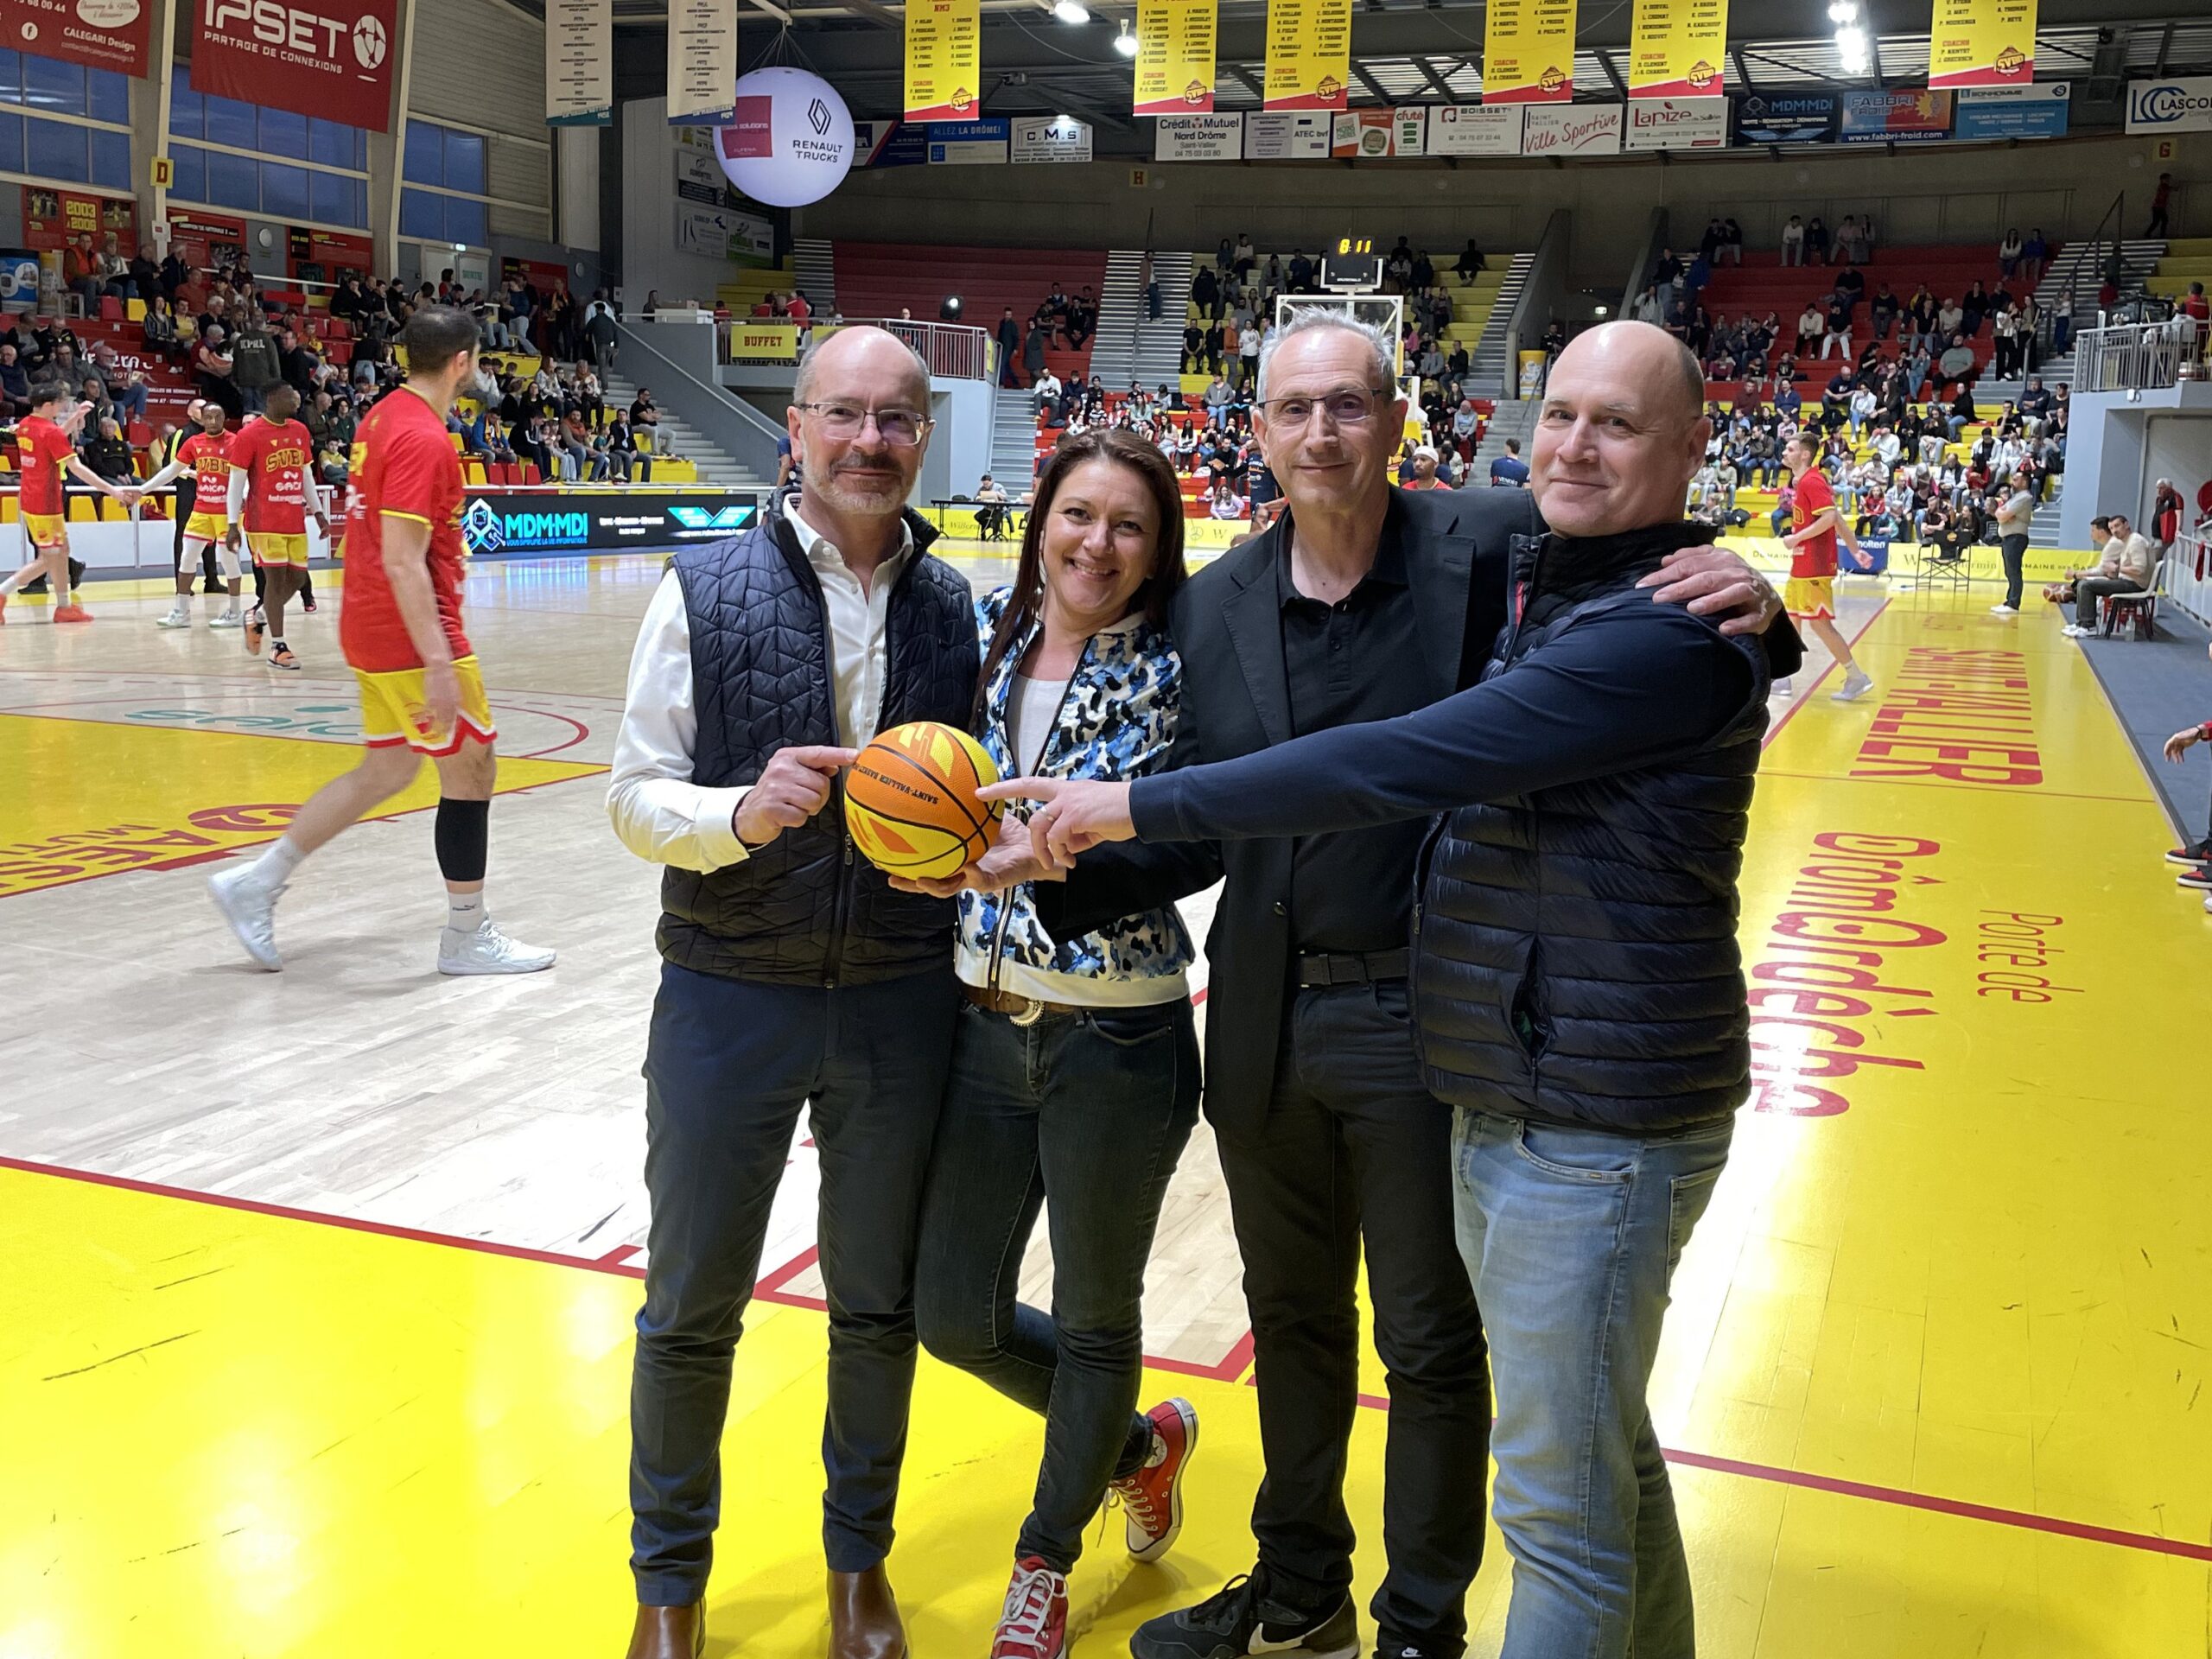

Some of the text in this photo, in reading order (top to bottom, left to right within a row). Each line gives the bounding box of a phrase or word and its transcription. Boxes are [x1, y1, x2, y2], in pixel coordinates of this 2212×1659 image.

[205, 0, 347, 58] IPSET
[63, 27, 136, 52] CALEGARI Design
[204, 31, 342, 73] PARTAGE DE CONNEXIONS
[1852, 95, 1914, 107] FABBRI
[2161, 98, 2212, 111] LASCO
[933, 126, 957, 136] ALLEZ
[958, 125, 969, 135] LA
[1160, 118, 1239, 129] Crédit Mutuel
[1198, 130, 1227, 140] Drôme
[1525, 134, 1558, 153] Ville
[1562, 113, 1618, 145] Sportive
[1848, 130, 1942, 142] www.fabbri-froid.com
[793, 140, 843, 154] RENAULT
[796, 150, 838, 163] TRUCKS
[156, 162, 168, 183] D
[1133, 172, 1144, 185] H
[66, 200, 96, 219] 2003
[744, 336, 783, 346] BUFFET
[1849, 646, 2044, 785] SAINT-VALLIER
[879, 774, 939, 804] SAINT-VALLIER
[1977, 909, 2085, 1003] Porte de
